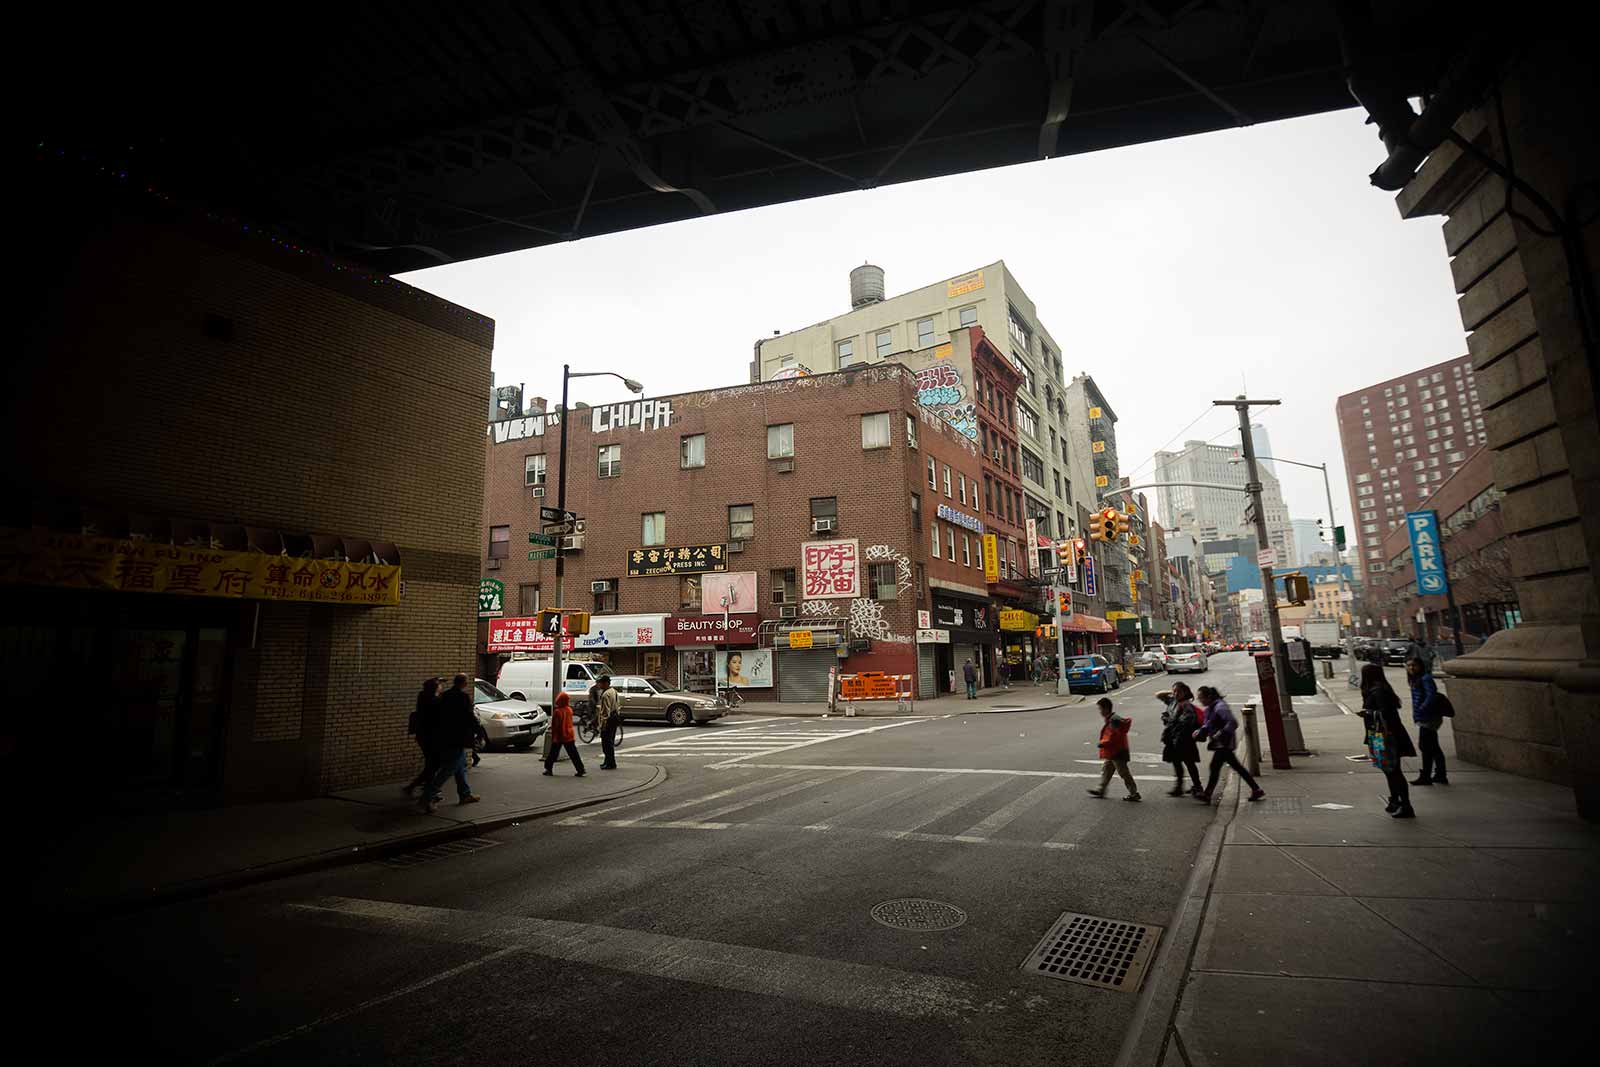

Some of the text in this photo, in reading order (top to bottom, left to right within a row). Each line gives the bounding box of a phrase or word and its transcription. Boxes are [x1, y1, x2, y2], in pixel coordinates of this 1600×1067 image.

[1413, 518, 1438, 570] PARK
[677, 620, 714, 631] BEAUTY
[715, 619, 743, 630] SHOP
